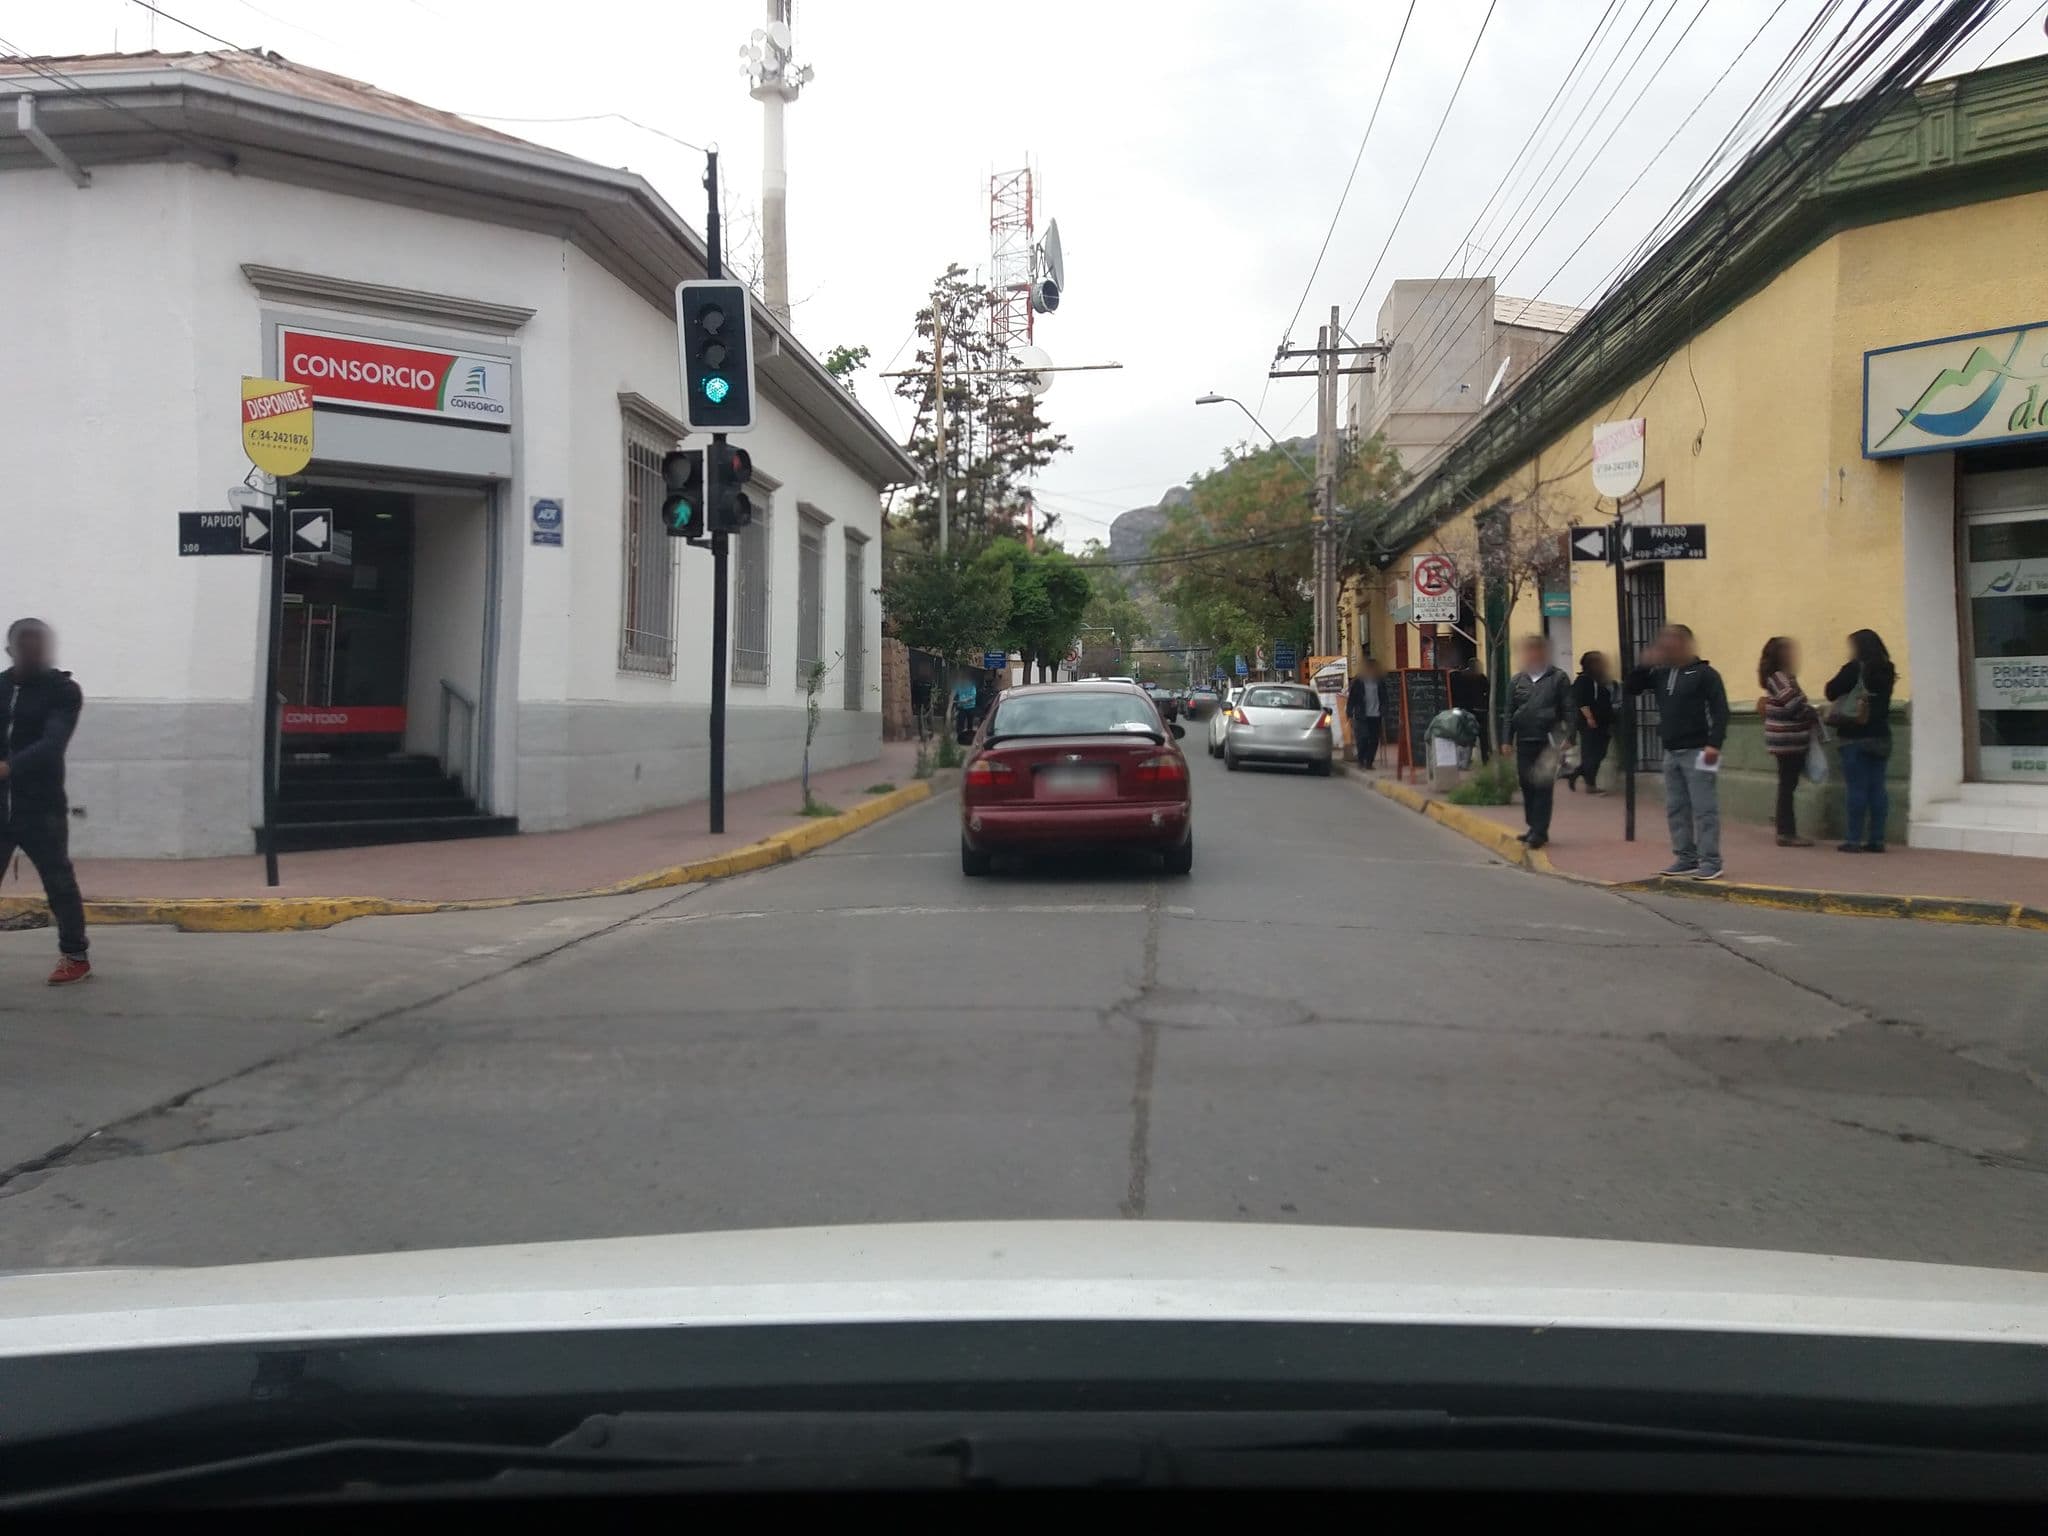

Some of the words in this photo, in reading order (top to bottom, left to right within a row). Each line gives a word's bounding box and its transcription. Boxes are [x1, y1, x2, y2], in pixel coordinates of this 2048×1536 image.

[293, 353, 436, 391] CONSORCIO
[246, 389, 309, 420] DISPONIBLE
[450, 398, 504, 414] CONSORCIO
[260, 430, 309, 445] 34-2421876
[201, 515, 241, 527] PAPUDO
[1651, 527, 1687, 538] PAPUDO
[286, 712, 312, 723] CON
